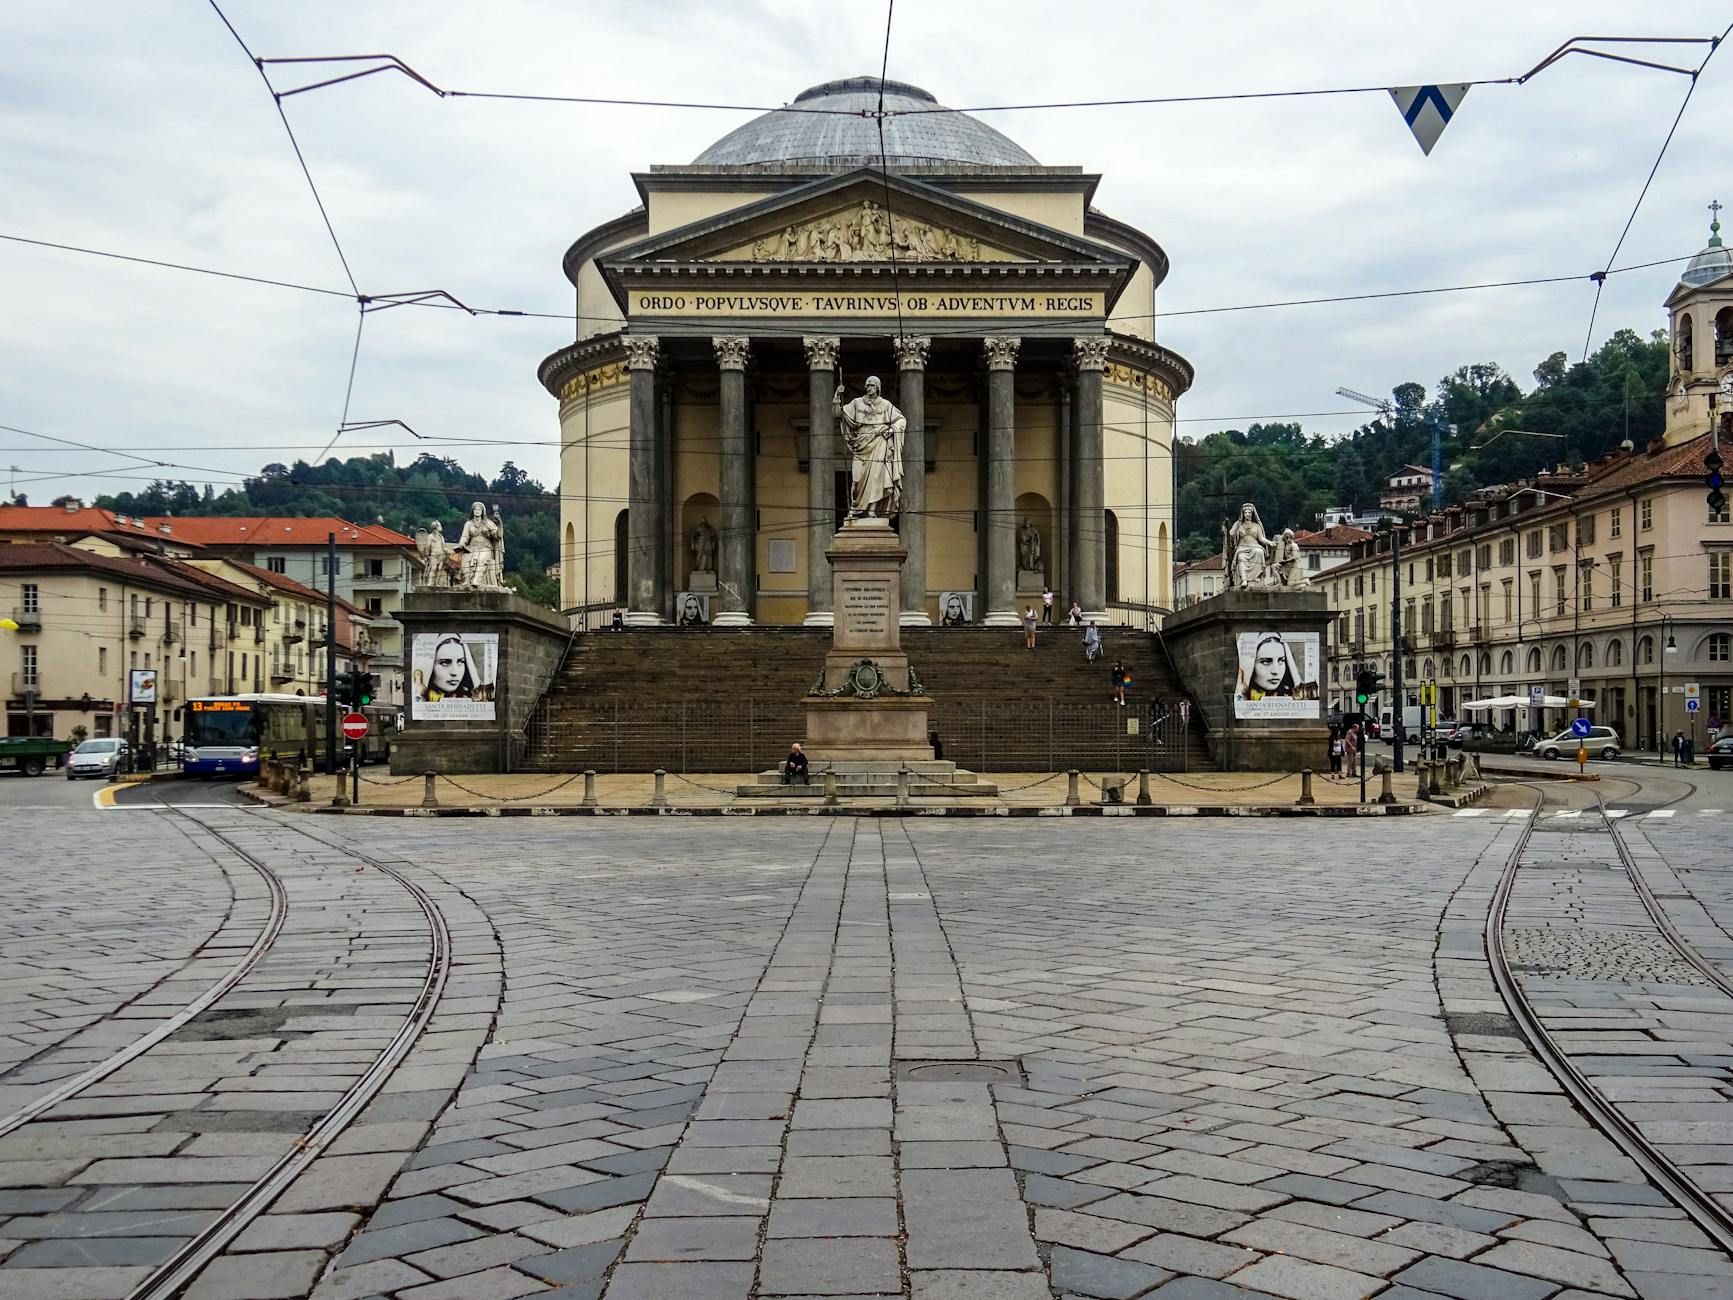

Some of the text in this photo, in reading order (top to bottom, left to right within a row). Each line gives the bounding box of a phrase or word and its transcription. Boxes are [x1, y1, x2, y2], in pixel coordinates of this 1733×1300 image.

[640, 296, 1093, 312] ORDO POPVLVSQVE TAVRINVS OB ADVENTVM REGIS
[192, 702, 203, 711] 13
